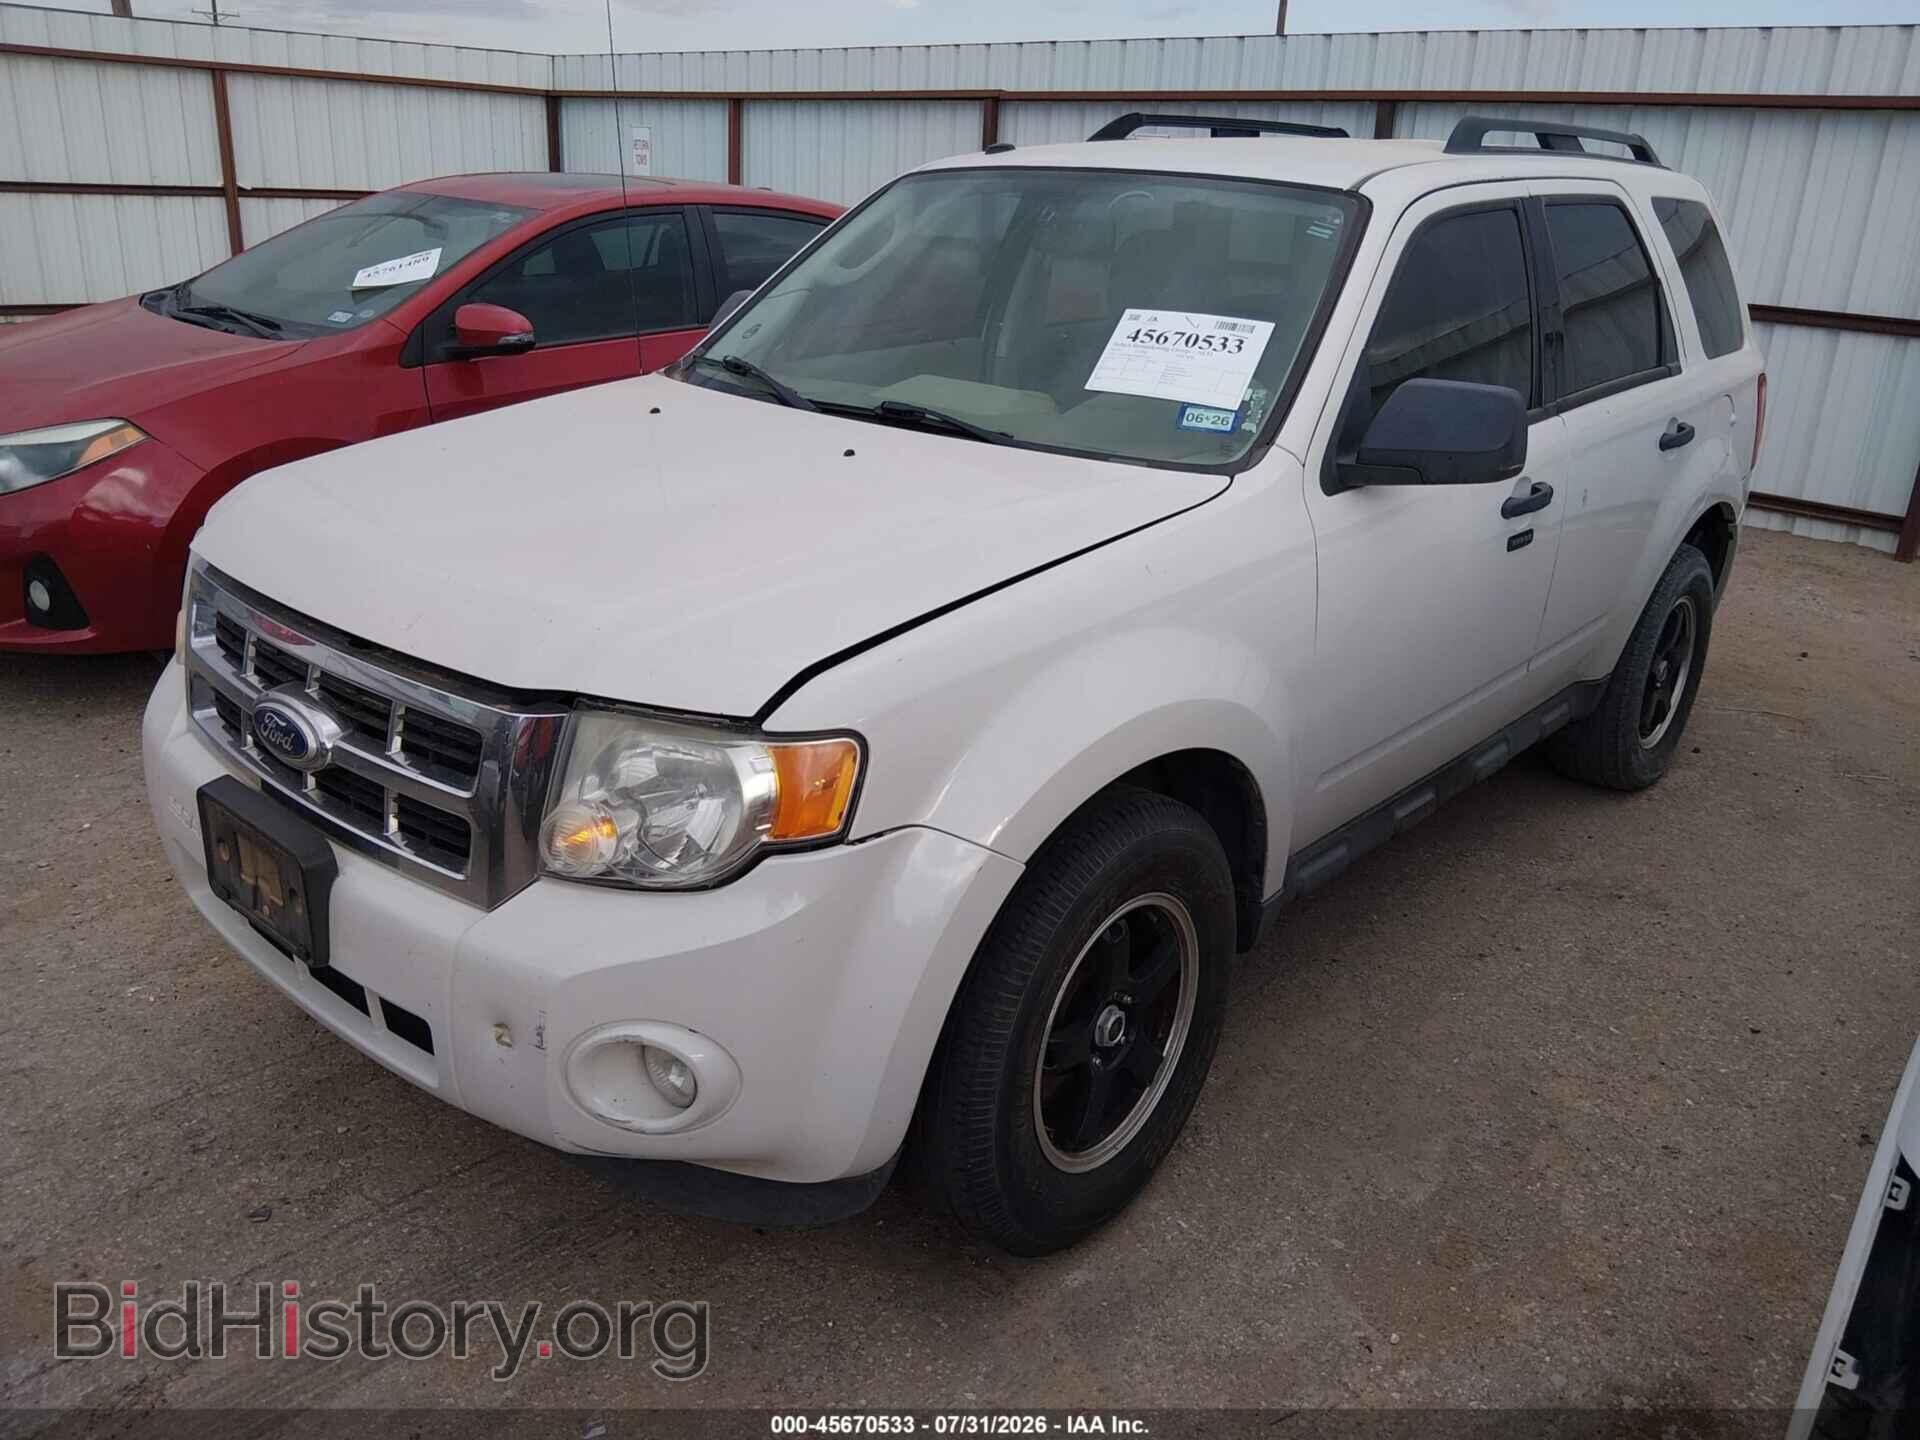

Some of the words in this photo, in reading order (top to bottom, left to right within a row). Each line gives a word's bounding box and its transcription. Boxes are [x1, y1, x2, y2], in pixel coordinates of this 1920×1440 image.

[1127, 327, 1245, 354] 45670533
[1186, 412, 1204, 424] 06
[1210, 416, 1230, 427] 26
[261, 712, 296, 751] Ford
